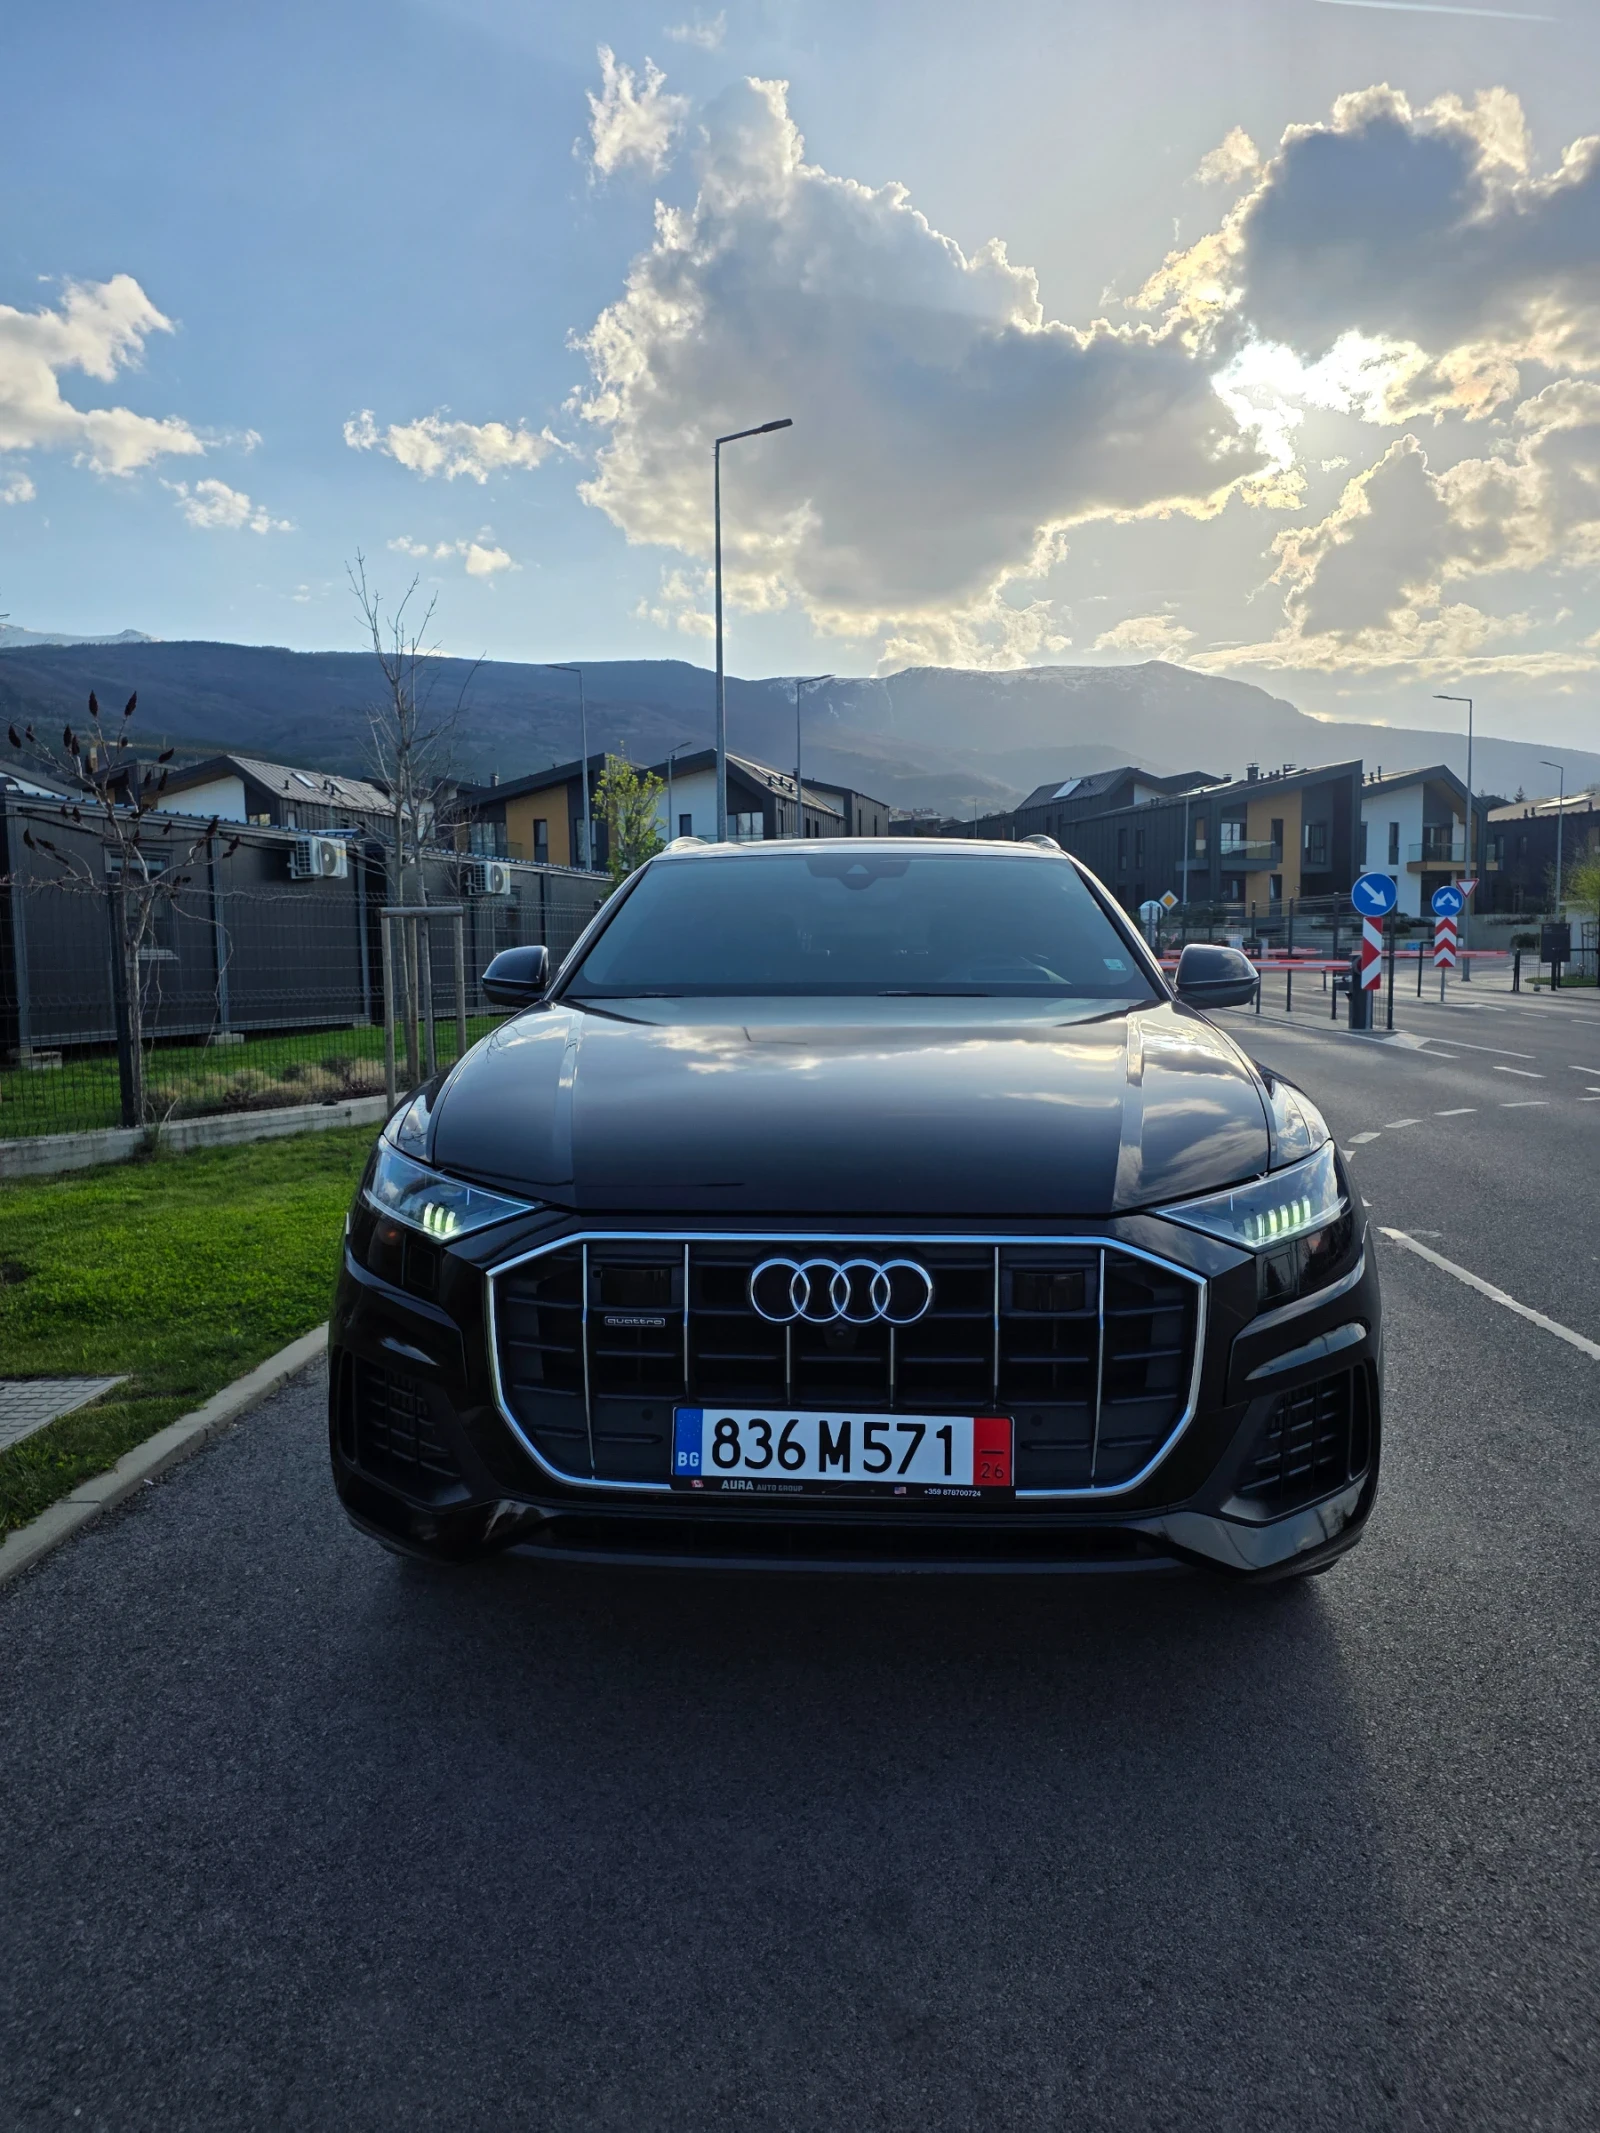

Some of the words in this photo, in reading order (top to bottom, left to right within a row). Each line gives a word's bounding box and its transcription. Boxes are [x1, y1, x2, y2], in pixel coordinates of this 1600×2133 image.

[712, 1417, 806, 1471] 836
[818, 1420, 851, 1474] M
[863, 1422, 952, 1476] 571
[677, 1451, 699, 1467] BG
[981, 1462, 1004, 1479] 26
[721, 1479, 754, 1491] AURA
